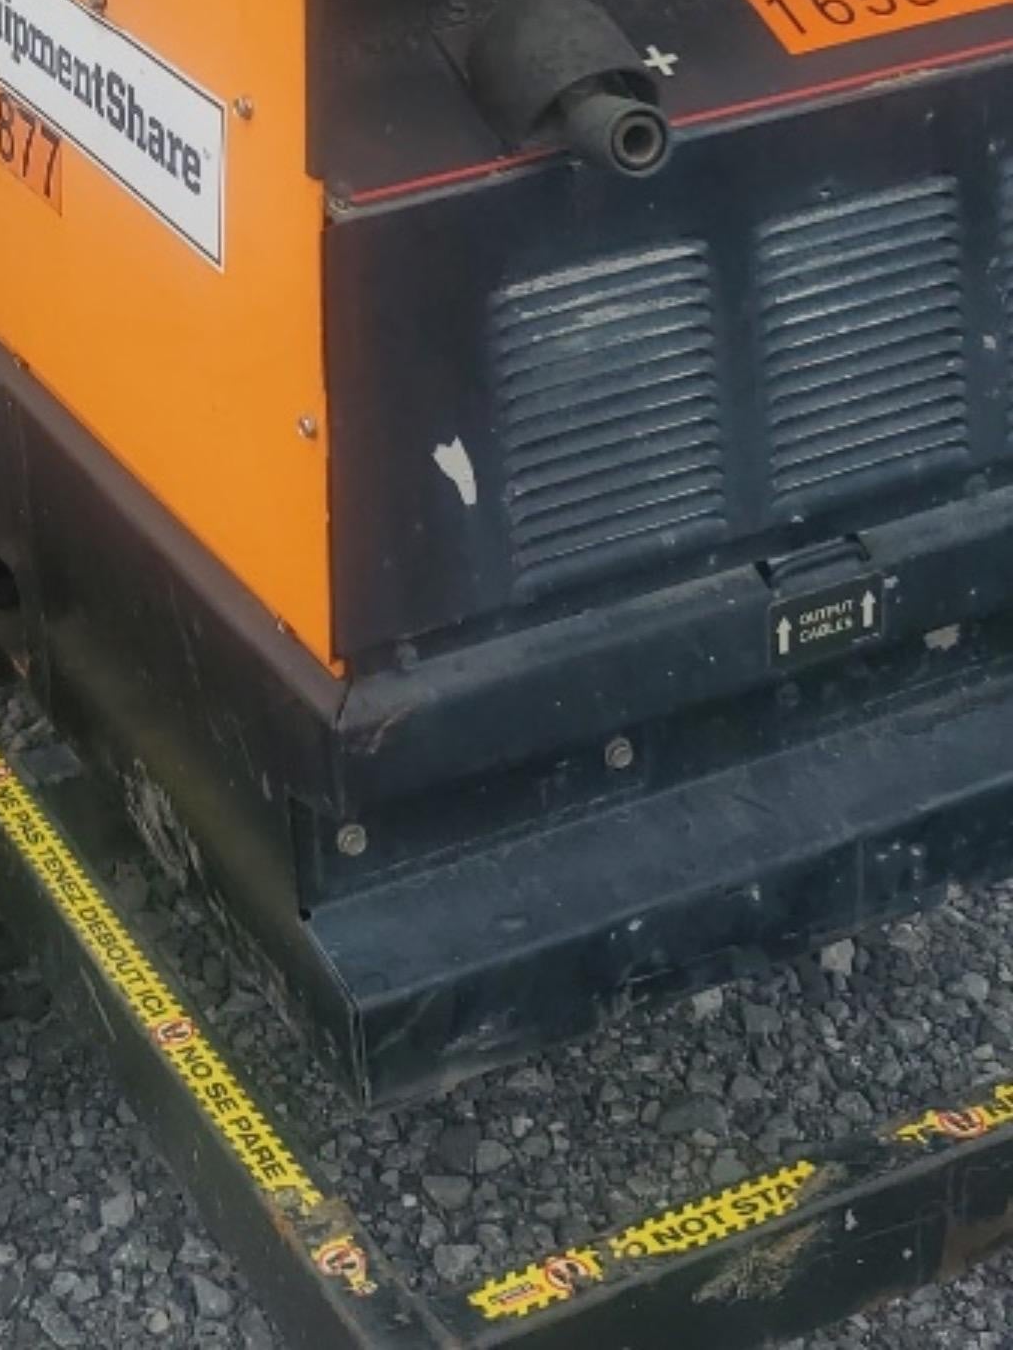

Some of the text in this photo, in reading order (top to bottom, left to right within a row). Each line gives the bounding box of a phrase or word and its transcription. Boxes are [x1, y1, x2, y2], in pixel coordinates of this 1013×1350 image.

[799, 599, 853, 625] OUTPUT
[11, 809, 47, 846] PAS
[38, 844, 88, 907] TENEZ
[79, 904, 149, 990] DEBOUT
[138, 987, 169, 1018] ICI
[175, 1045, 288, 1181] NO SE PARE
[649, 1208, 727, 1247] NOT
[730, 1176, 806, 1217] STA
